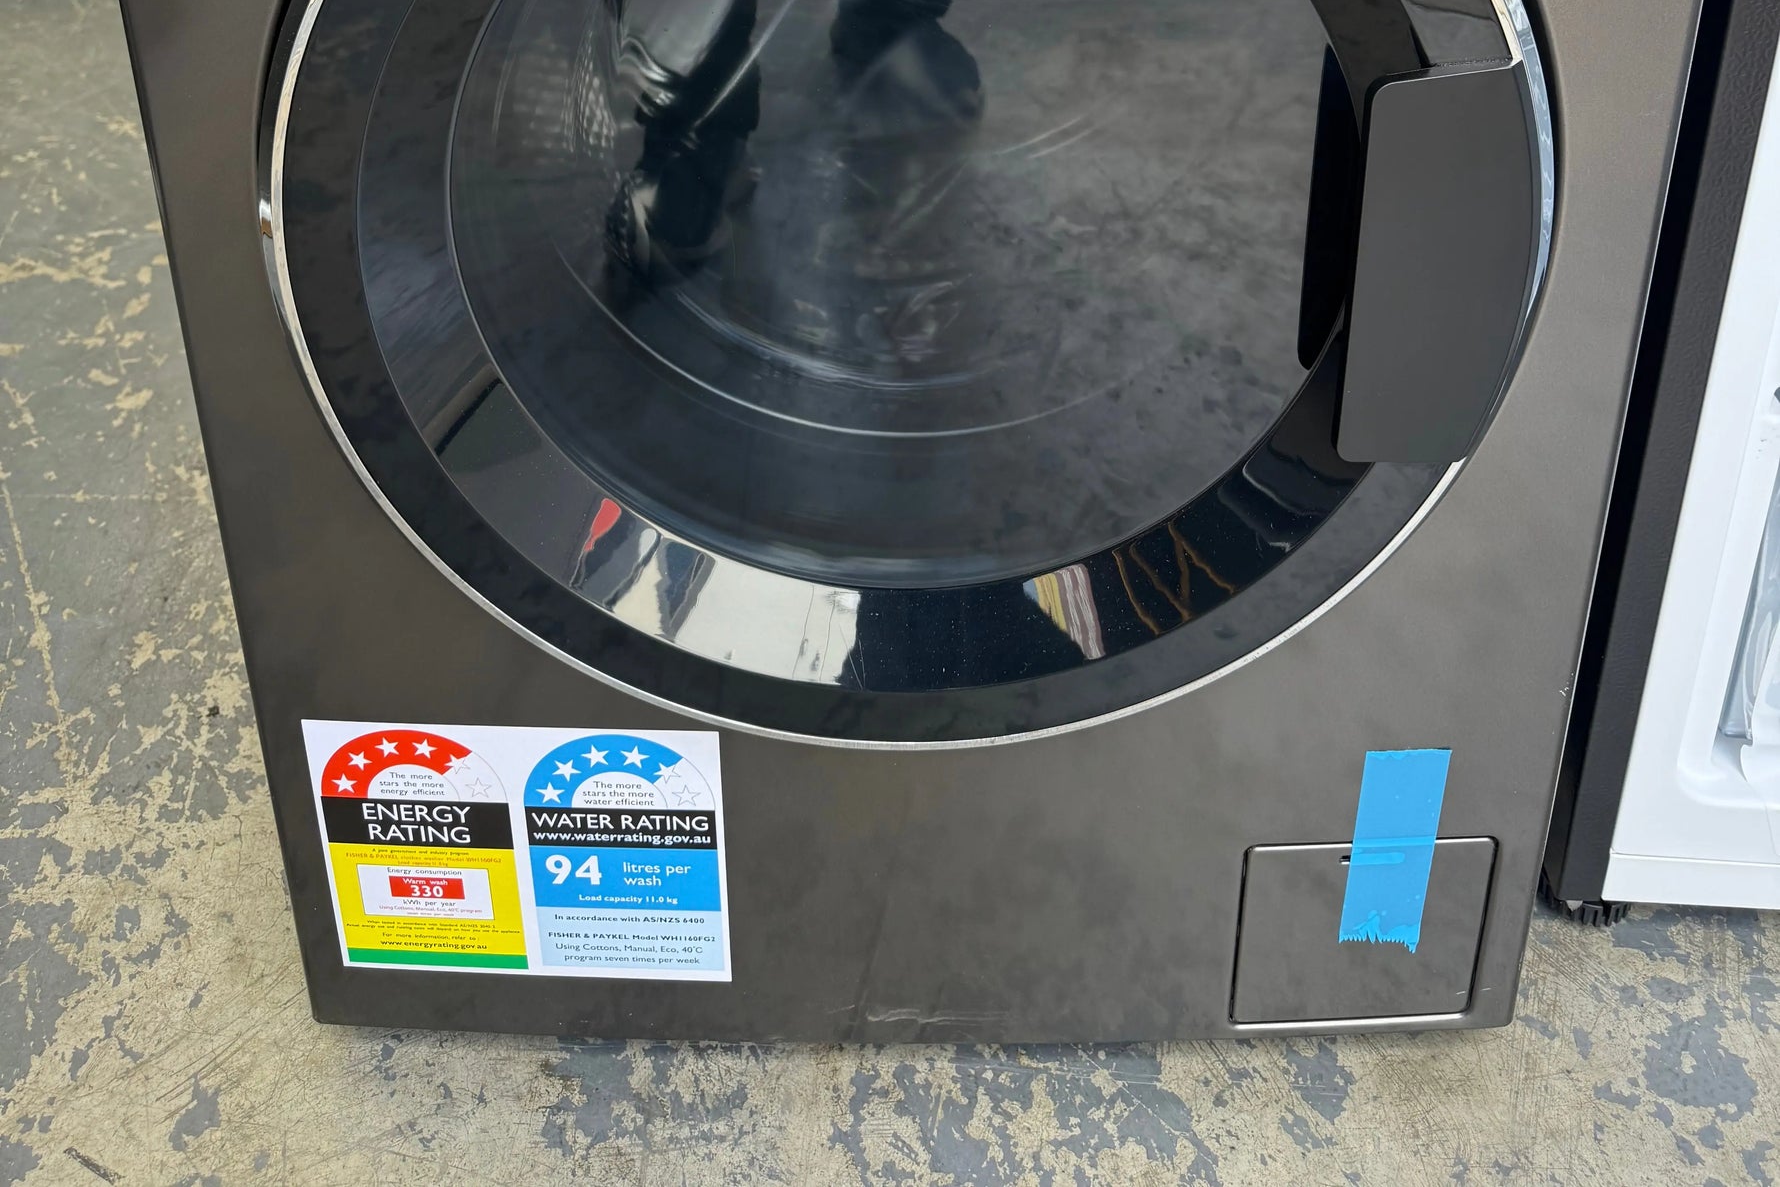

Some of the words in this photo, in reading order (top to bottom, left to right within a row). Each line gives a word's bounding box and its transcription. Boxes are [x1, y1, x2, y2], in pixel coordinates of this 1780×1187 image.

[593, 781, 613, 789] The
[413, 788, 445, 796] efficient
[616, 798, 654, 806] efficient
[362, 803, 471, 823] ENERGY
[532, 813, 614, 829] WATER
[621, 815, 709, 831] RATING
[368, 824, 471, 843] RATING
[533, 831, 711, 845] www.waterrating.gov.au
[545, 854, 602, 885] 94
[623, 862, 660, 873] litres
[666, 865, 691, 876] per
[624, 875, 661, 886] wash
[411, 885, 443, 897] 330
[381, 940, 487, 949] www.energyrating.gov.au
[556, 943, 580, 951] Using
[583, 943, 622, 951] Cottons,
[625, 945, 658, 953] Manual,
